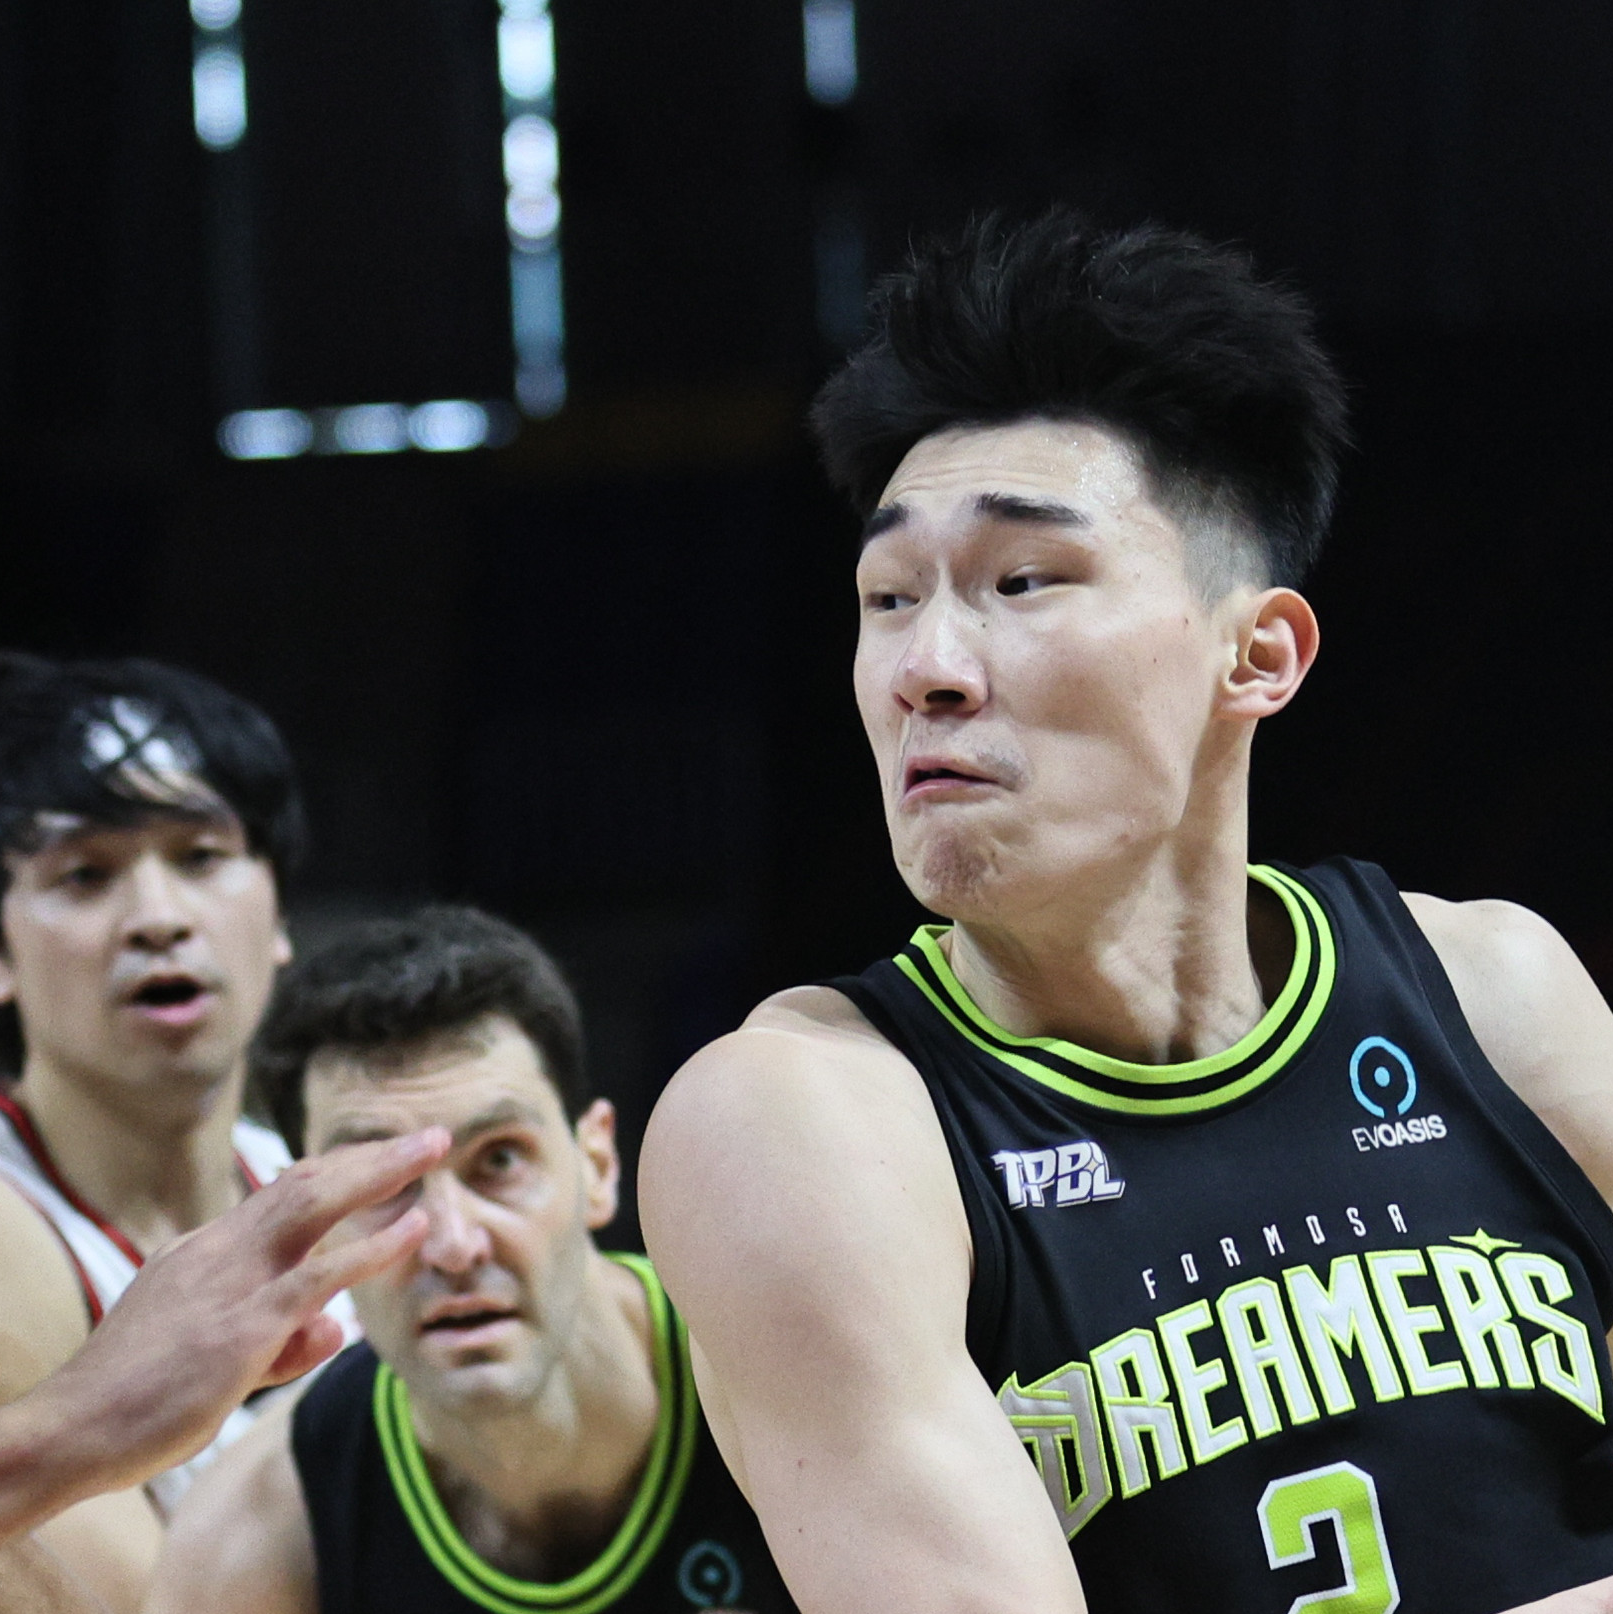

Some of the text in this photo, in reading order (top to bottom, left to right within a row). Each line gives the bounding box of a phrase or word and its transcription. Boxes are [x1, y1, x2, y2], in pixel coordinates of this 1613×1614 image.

[993, 1139, 1127, 1209] TPBL
[1353, 1113, 1448, 1153] EVOASIS
[1143, 1203, 1408, 1299] FORMOSA
[997, 1236, 1605, 1542] DREAMERS
